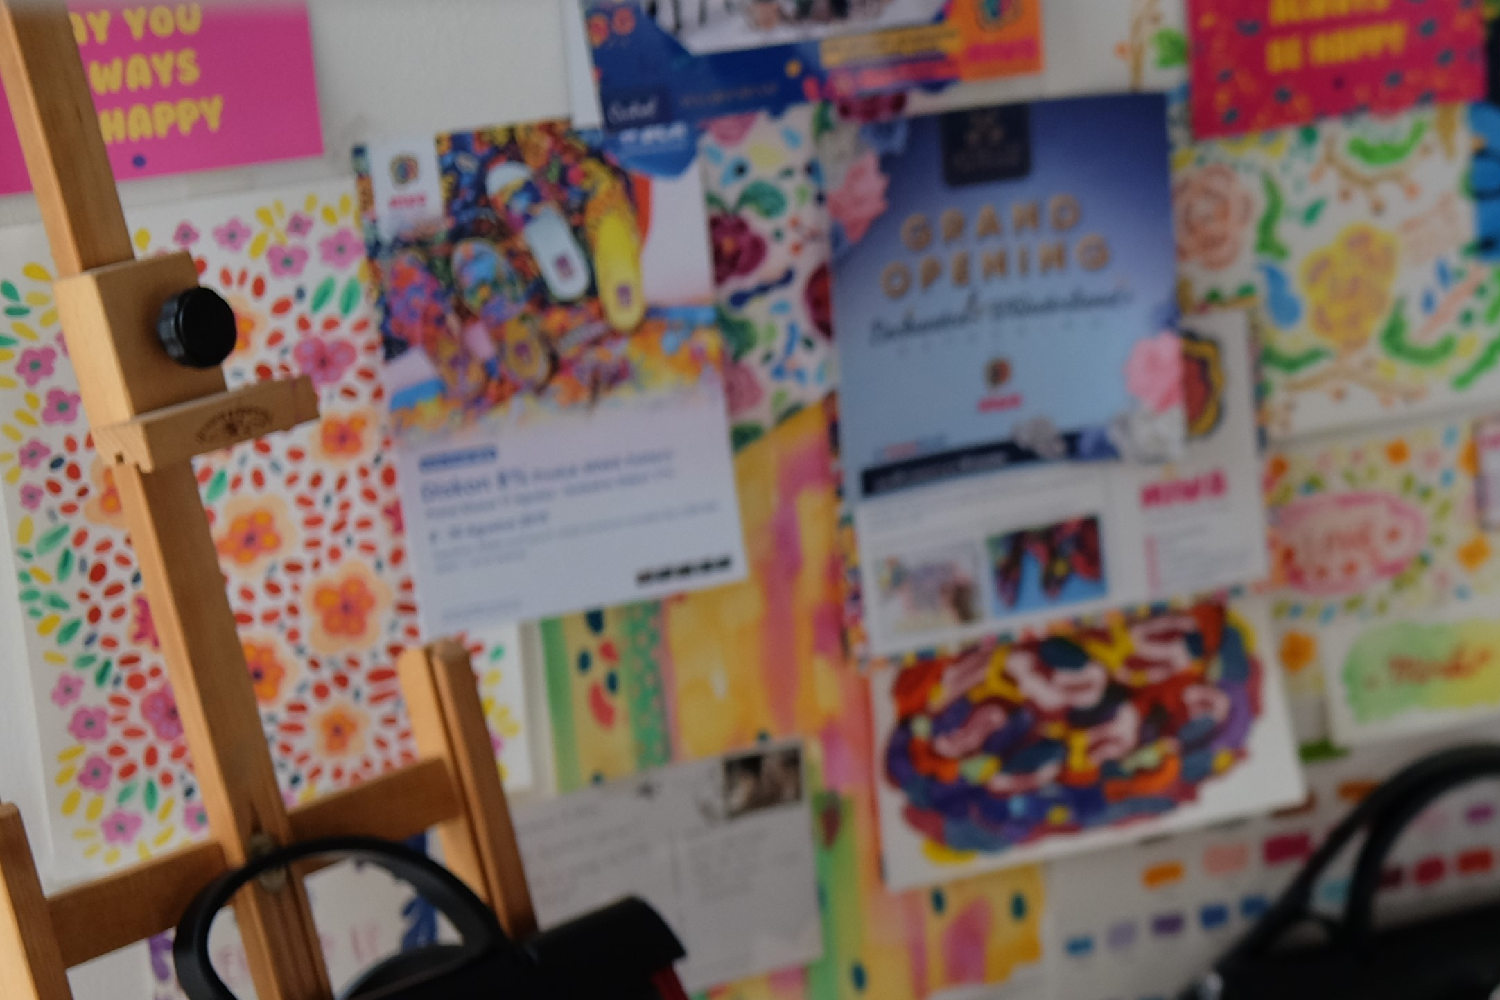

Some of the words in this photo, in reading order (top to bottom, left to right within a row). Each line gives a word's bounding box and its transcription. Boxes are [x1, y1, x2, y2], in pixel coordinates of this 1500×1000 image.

[123, 3, 203, 42] YOU
[1308, 19, 1407, 67] HAPPY
[97, 93, 223, 144] HAPPY
[902, 193, 1081, 252] GRAND
[880, 234, 1111, 300] OPENING
